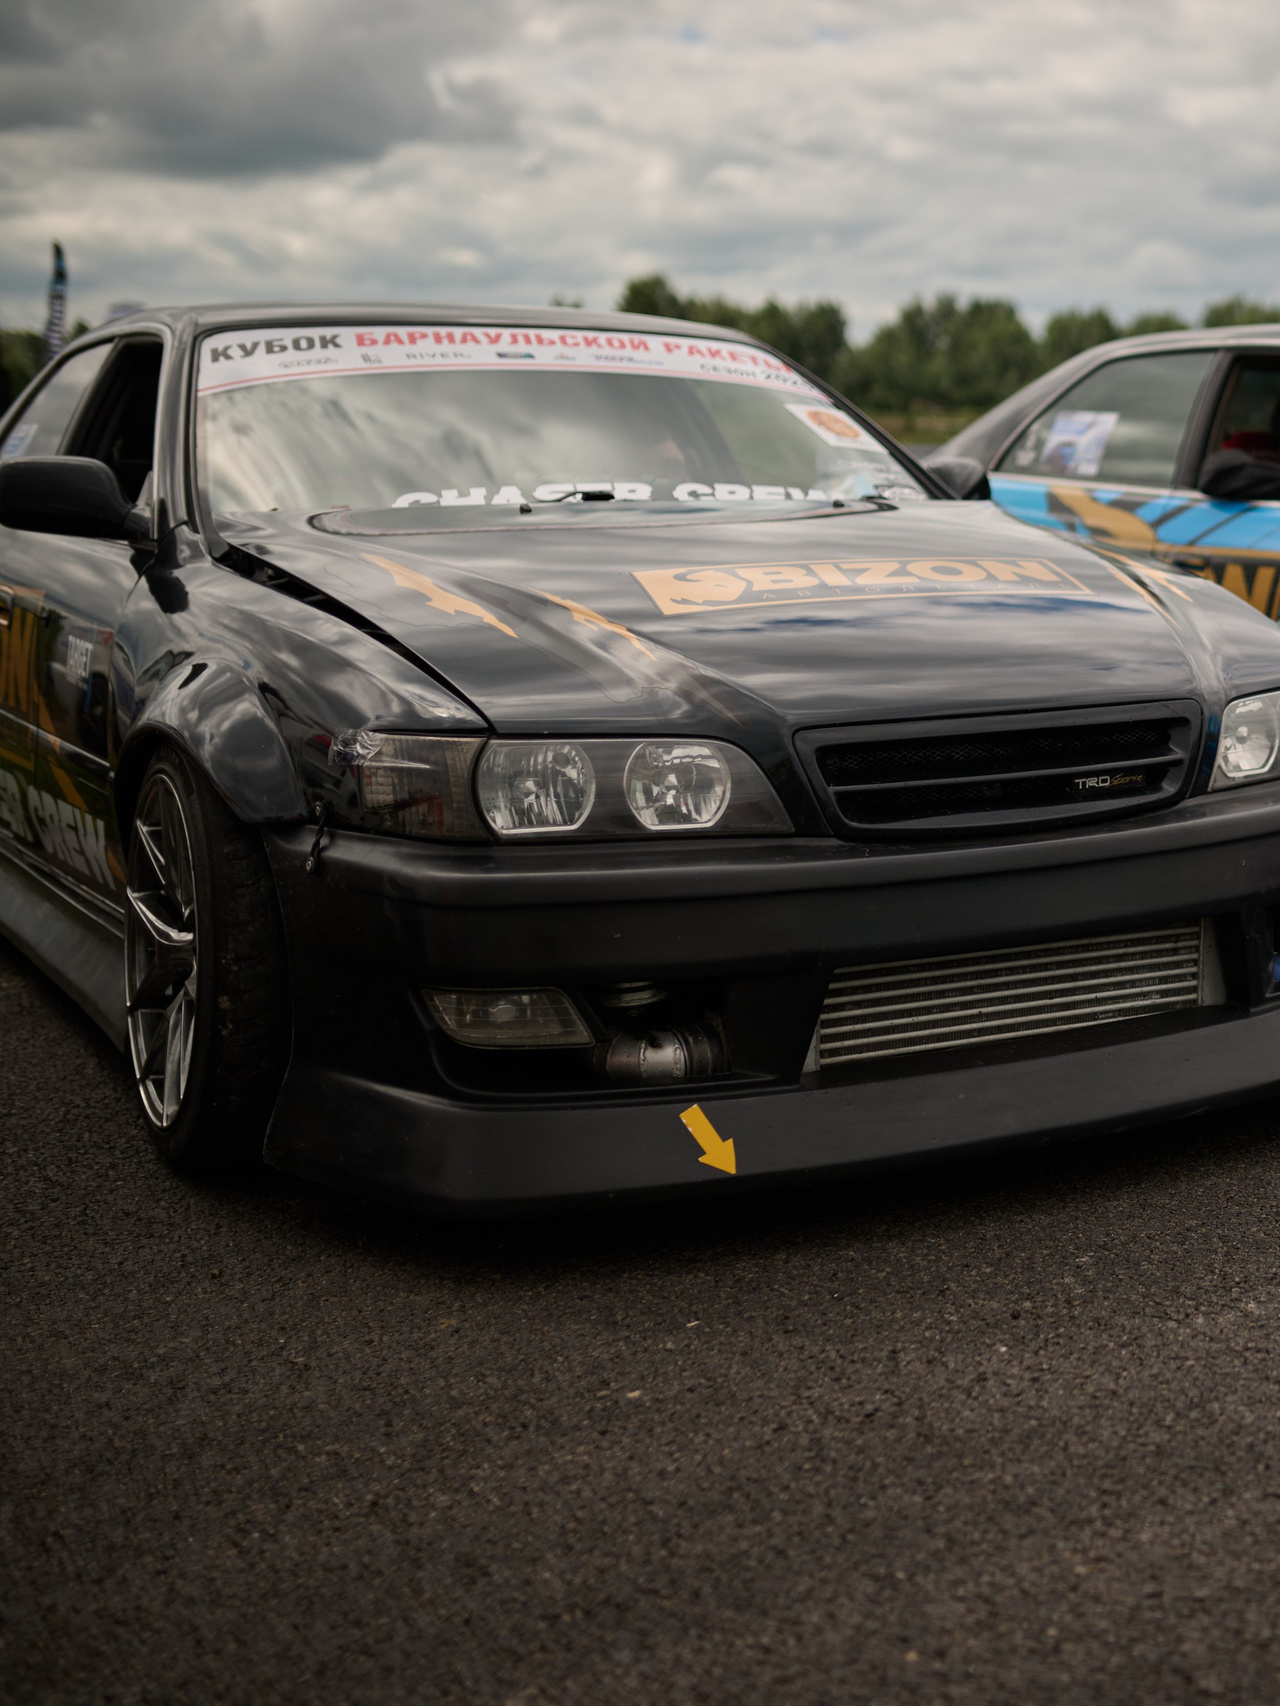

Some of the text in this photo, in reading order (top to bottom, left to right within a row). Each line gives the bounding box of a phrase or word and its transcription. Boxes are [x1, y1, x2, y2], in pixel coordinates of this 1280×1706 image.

[210, 333, 343, 363] КУБОК
[355, 330, 650, 352] БАРНАУЛЬСКОЙ
[735, 560, 1061, 591] BIZON
[66, 634, 93, 679] TARGET
[1074, 775, 1110, 789] TRD
[27, 784, 117, 892] CREW
